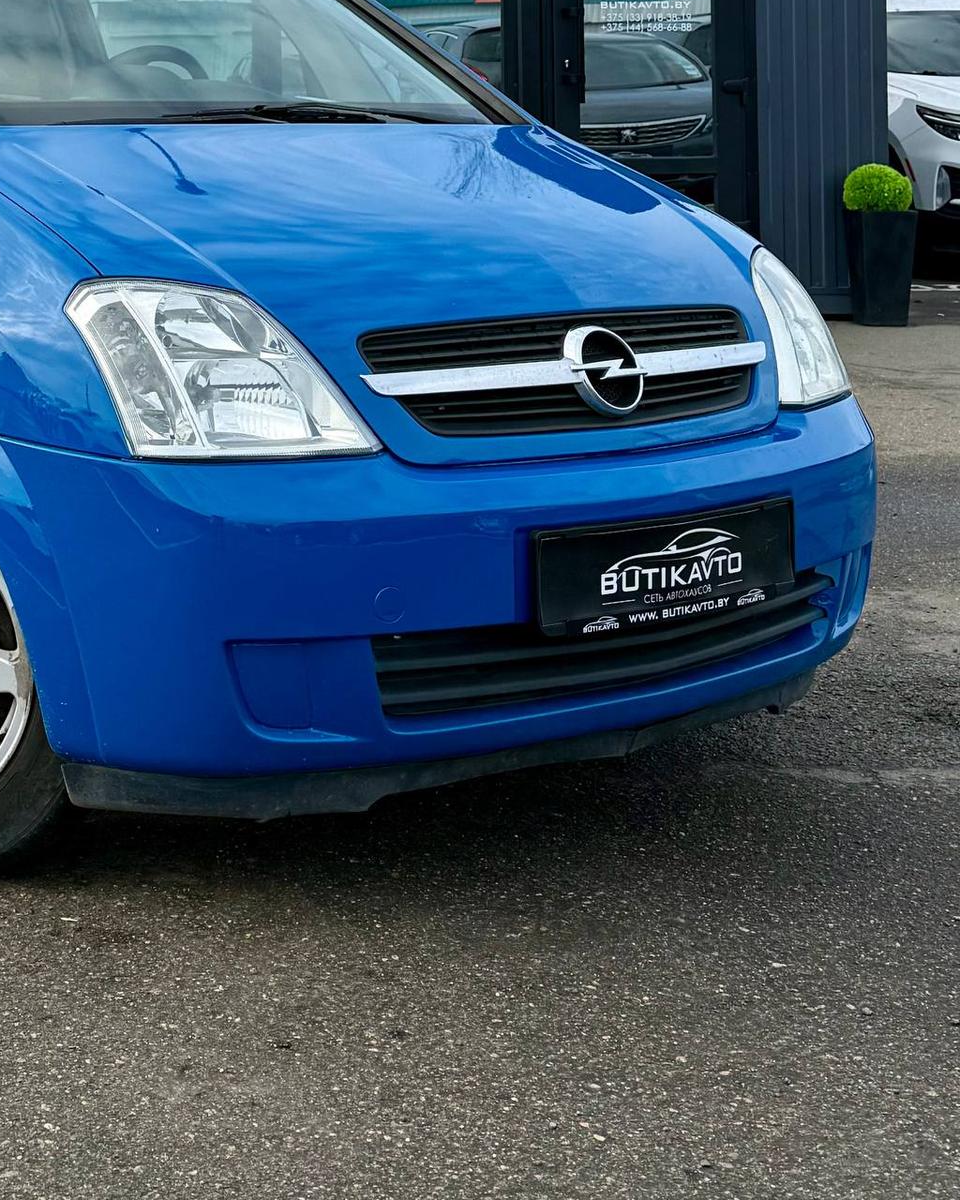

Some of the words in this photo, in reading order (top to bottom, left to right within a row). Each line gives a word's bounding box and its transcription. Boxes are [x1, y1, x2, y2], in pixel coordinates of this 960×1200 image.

[600, 1, 691, 9] BUTIKAVTO.BY
[601, 23, 623, 31] +375
[626, 23, 644, 33] (44)
[647, 23, 692, 31] 568-66-88
[601, 552, 742, 595] BUTIKAVTO
[644, 592, 663, 603] СЕТЬ
[666, 584, 712, 600] АВТОХАУСОВ
[629, 611, 658, 623] WWW.
[662, 598, 729, 619] BUTIKAVTO.BY
[583, 622, 619, 633] BUTIKAVTO
